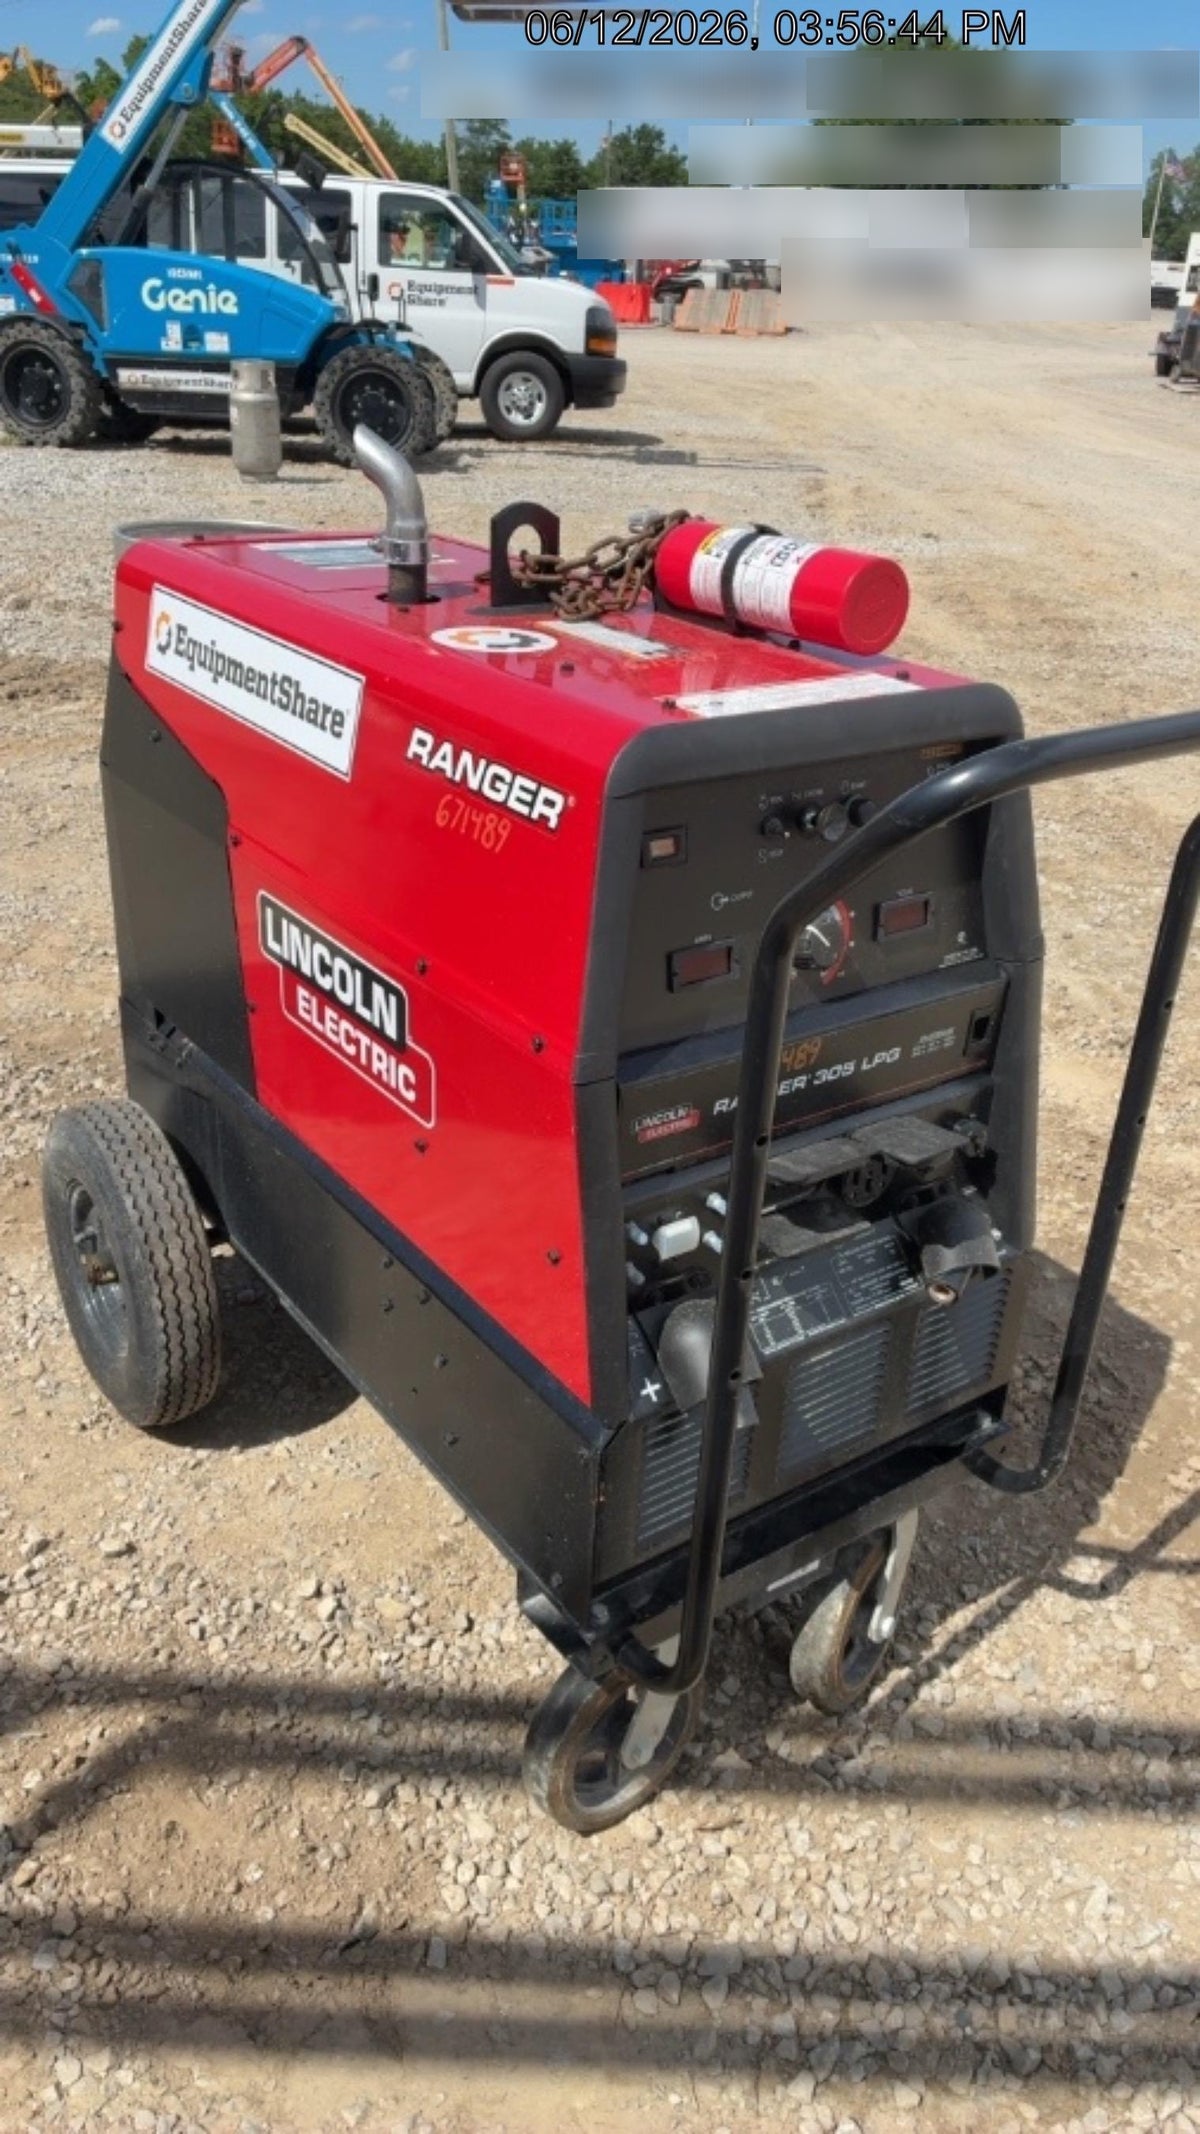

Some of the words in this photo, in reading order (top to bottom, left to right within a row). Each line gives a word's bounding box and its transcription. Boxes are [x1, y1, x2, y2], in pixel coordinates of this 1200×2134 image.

[141, 277, 239, 314] Genie
[407, 279, 479, 297] Equipment
[407, 293, 446, 307] Share
[174, 623, 346, 739] EquipmentShare
[406, 727, 566, 830] RANGER
[435, 793, 512, 854] 671489
[265, 907, 397, 1042] LINCOLN
[296, 984, 416, 1103] ELECTRIC
[781, 1036, 823, 1073] 489
[713, 1074, 808, 1116] RAER
[813, 1059, 856, 1085] 305
